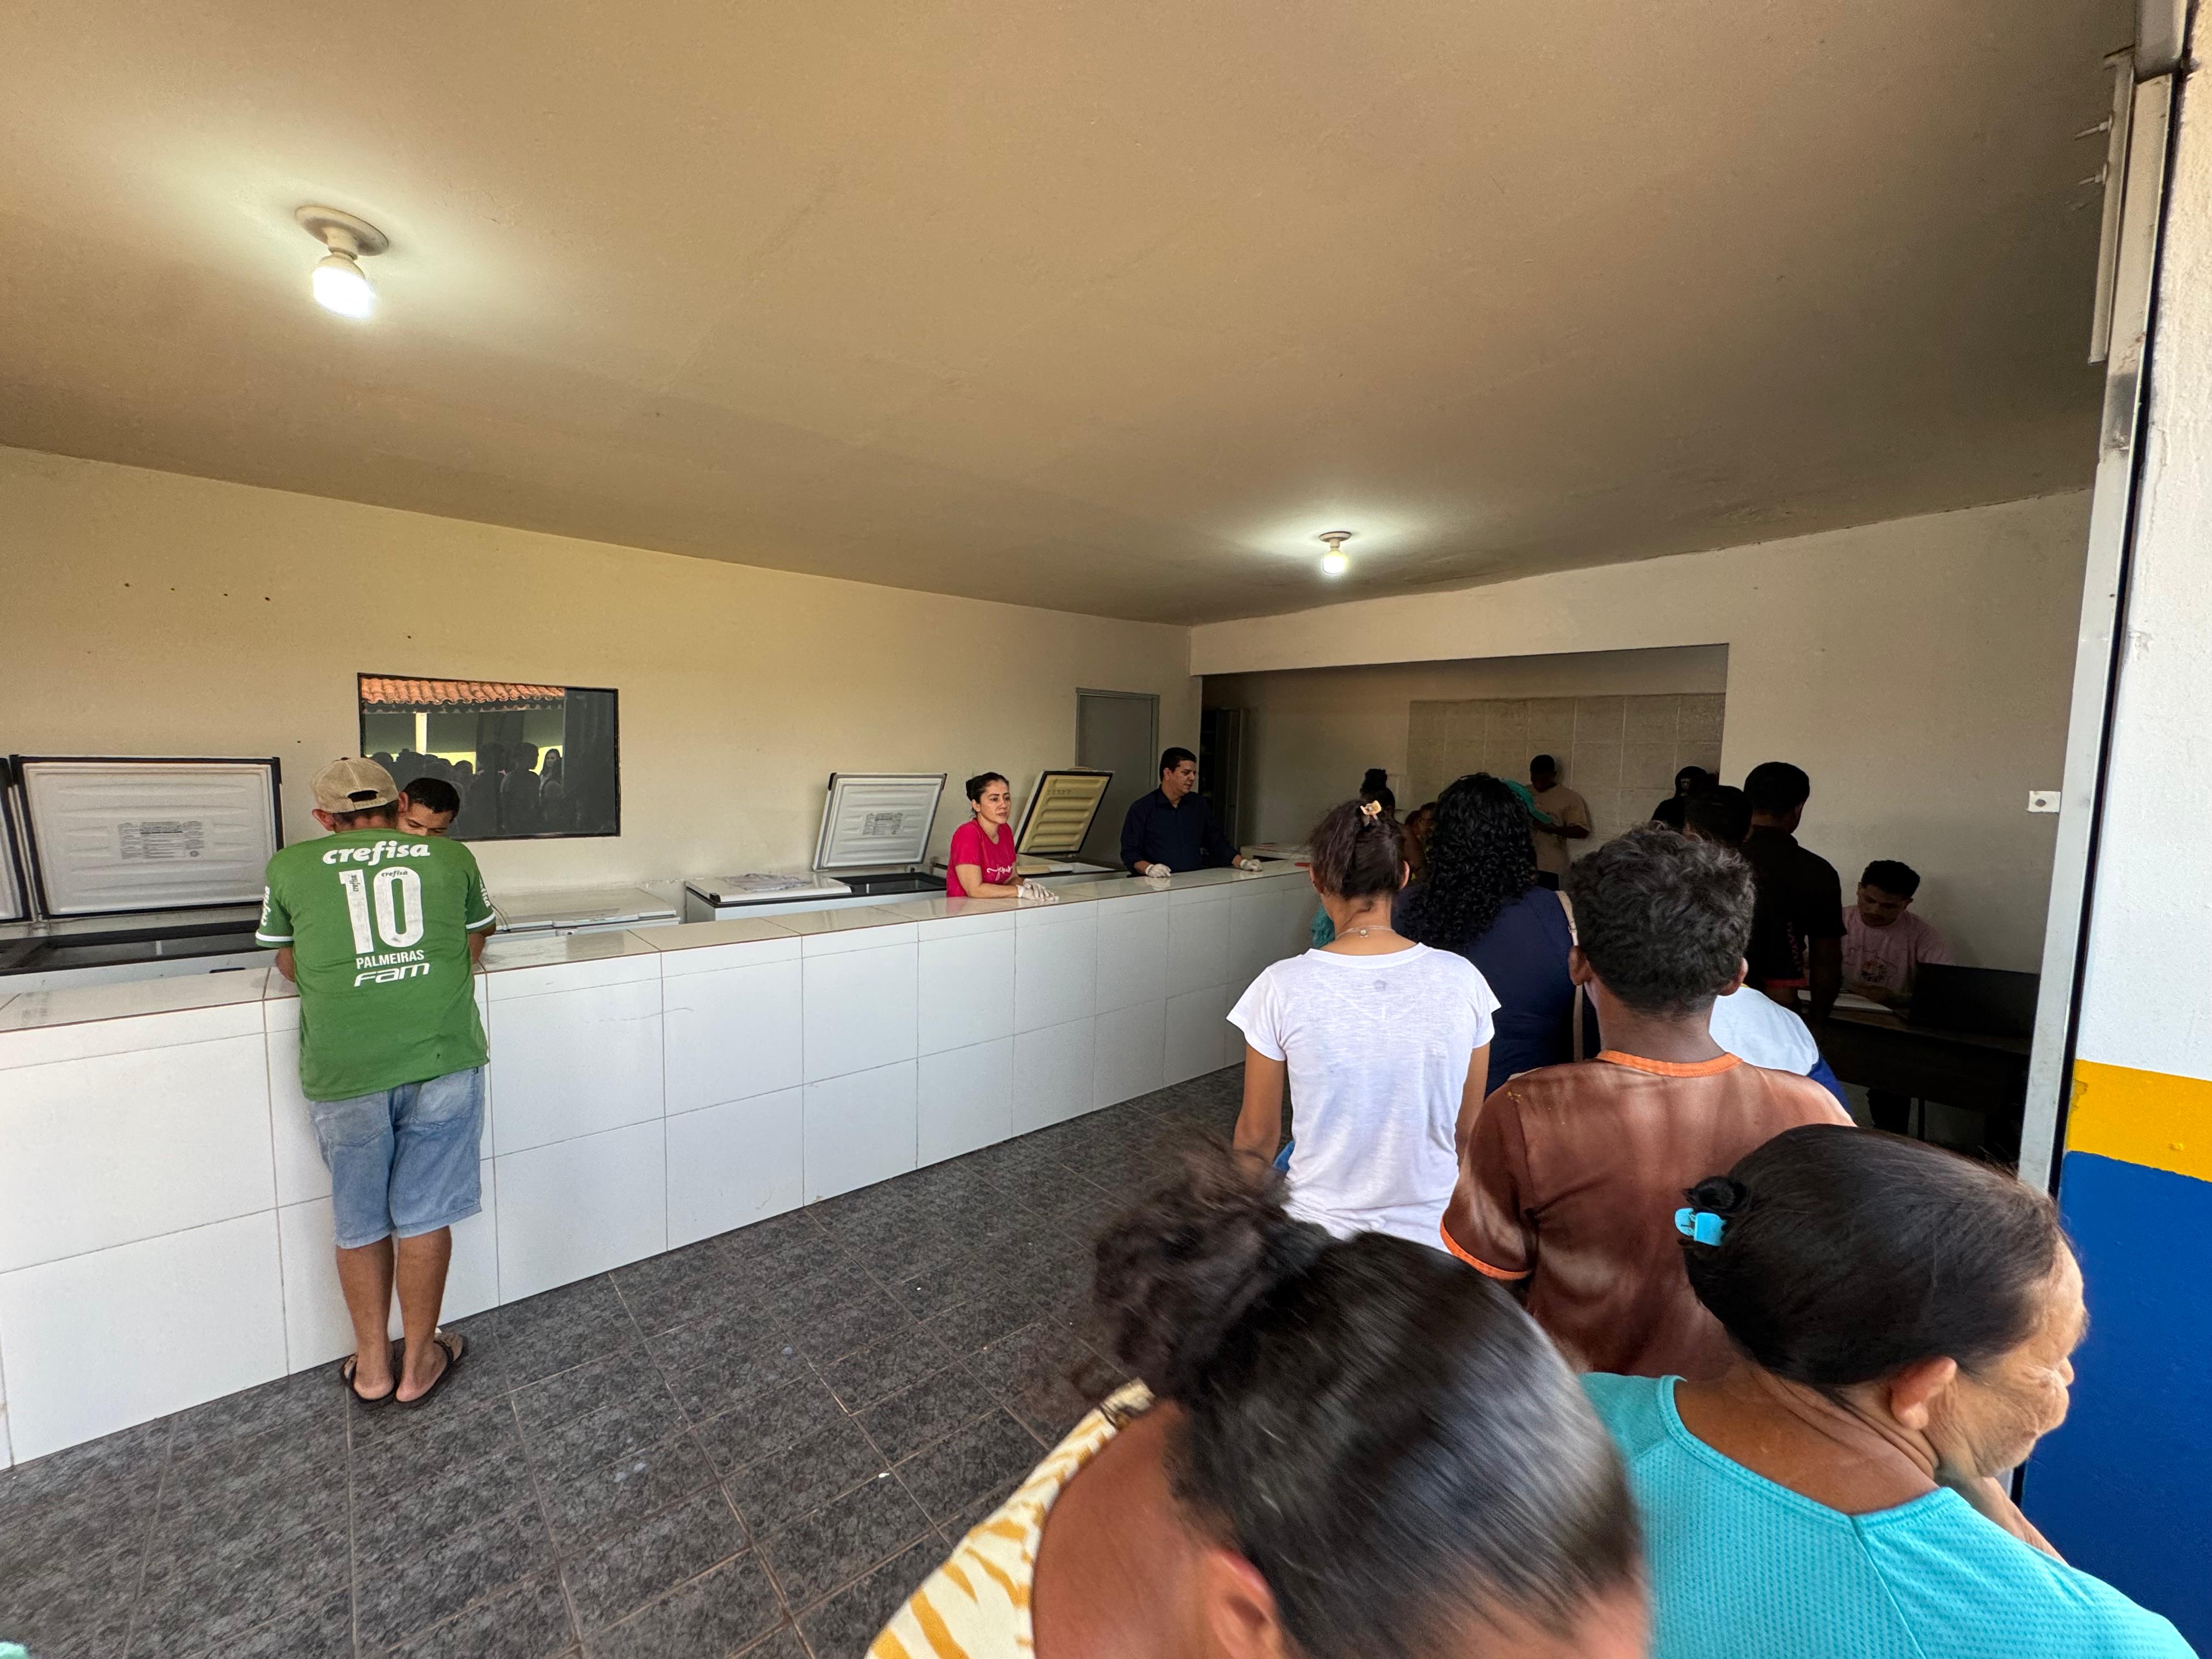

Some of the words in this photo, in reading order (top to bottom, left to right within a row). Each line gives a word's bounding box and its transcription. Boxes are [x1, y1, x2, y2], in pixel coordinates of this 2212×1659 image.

[323, 840, 431, 866] crefisa
[338, 867, 424, 954] 10
[356, 950, 425, 969] PALMEIRAS
